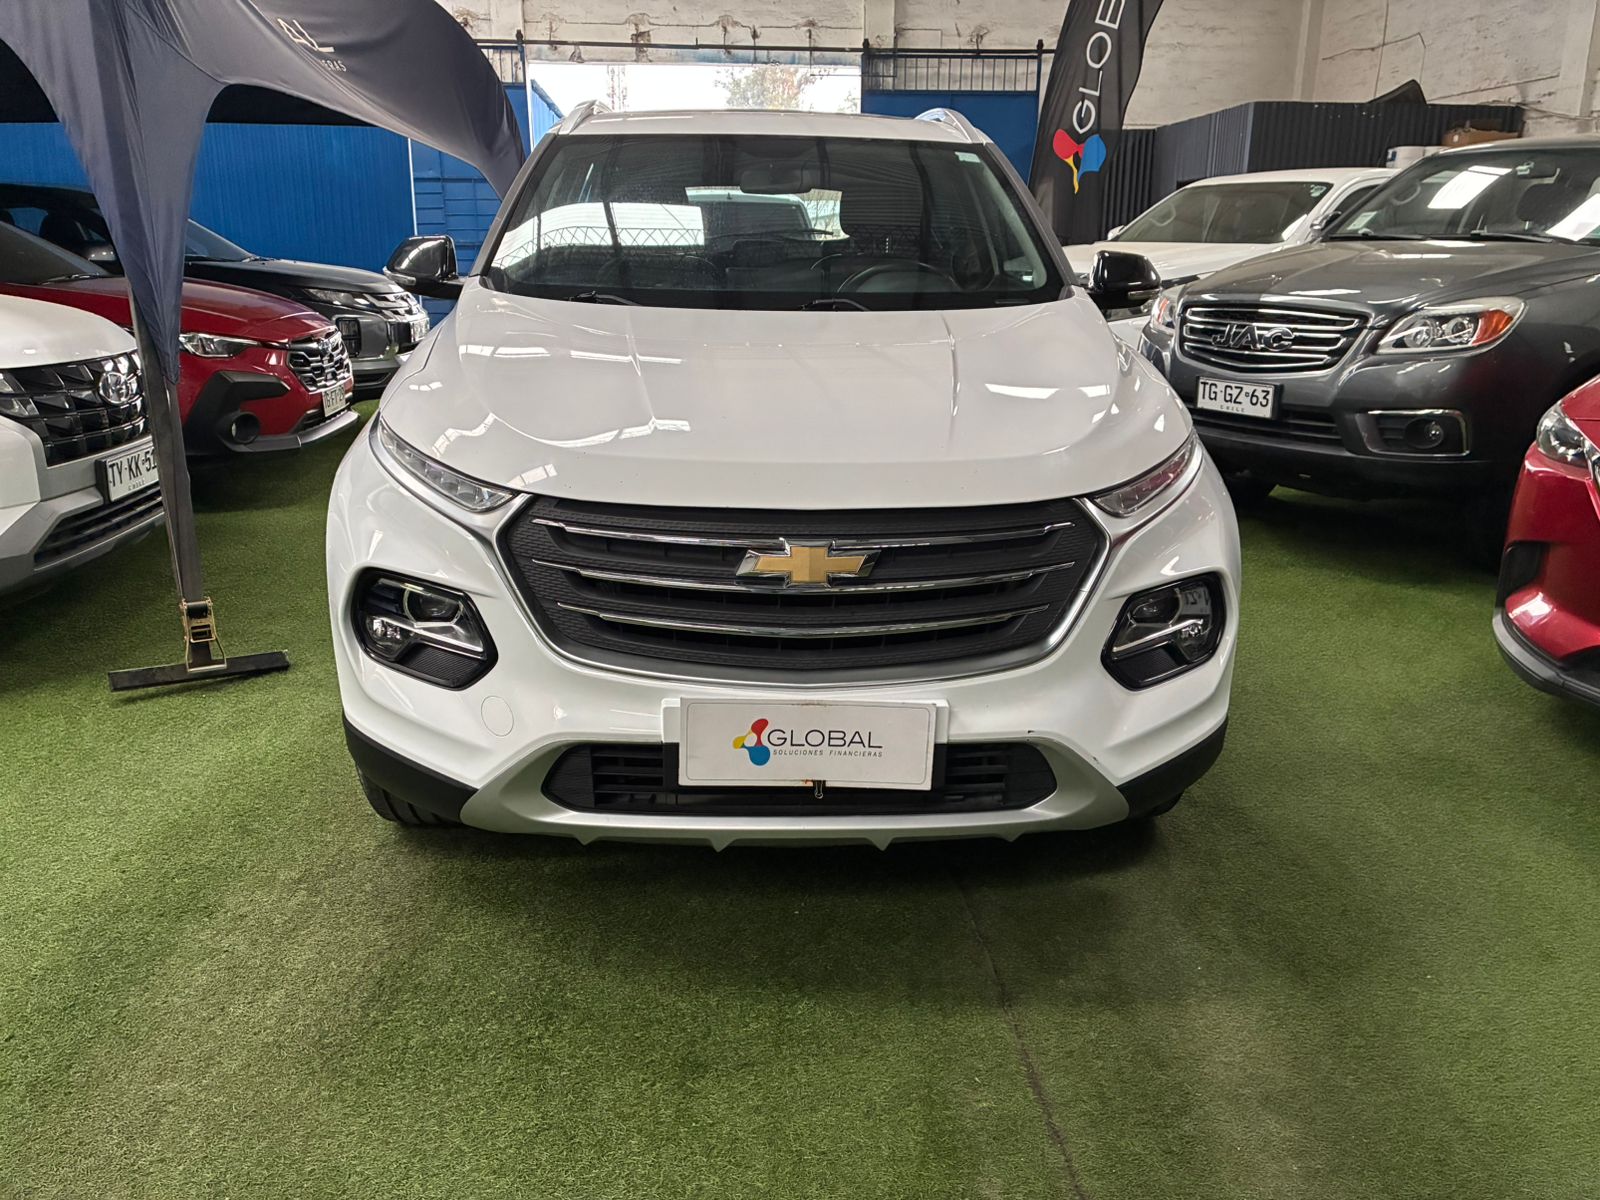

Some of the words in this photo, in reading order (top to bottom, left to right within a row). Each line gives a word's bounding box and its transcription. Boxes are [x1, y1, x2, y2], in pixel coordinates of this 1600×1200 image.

[1211, 324, 1295, 352] JAC
[767, 728, 883, 749] GLOBAL
[829, 750, 883, 758] FINANCIERAS
